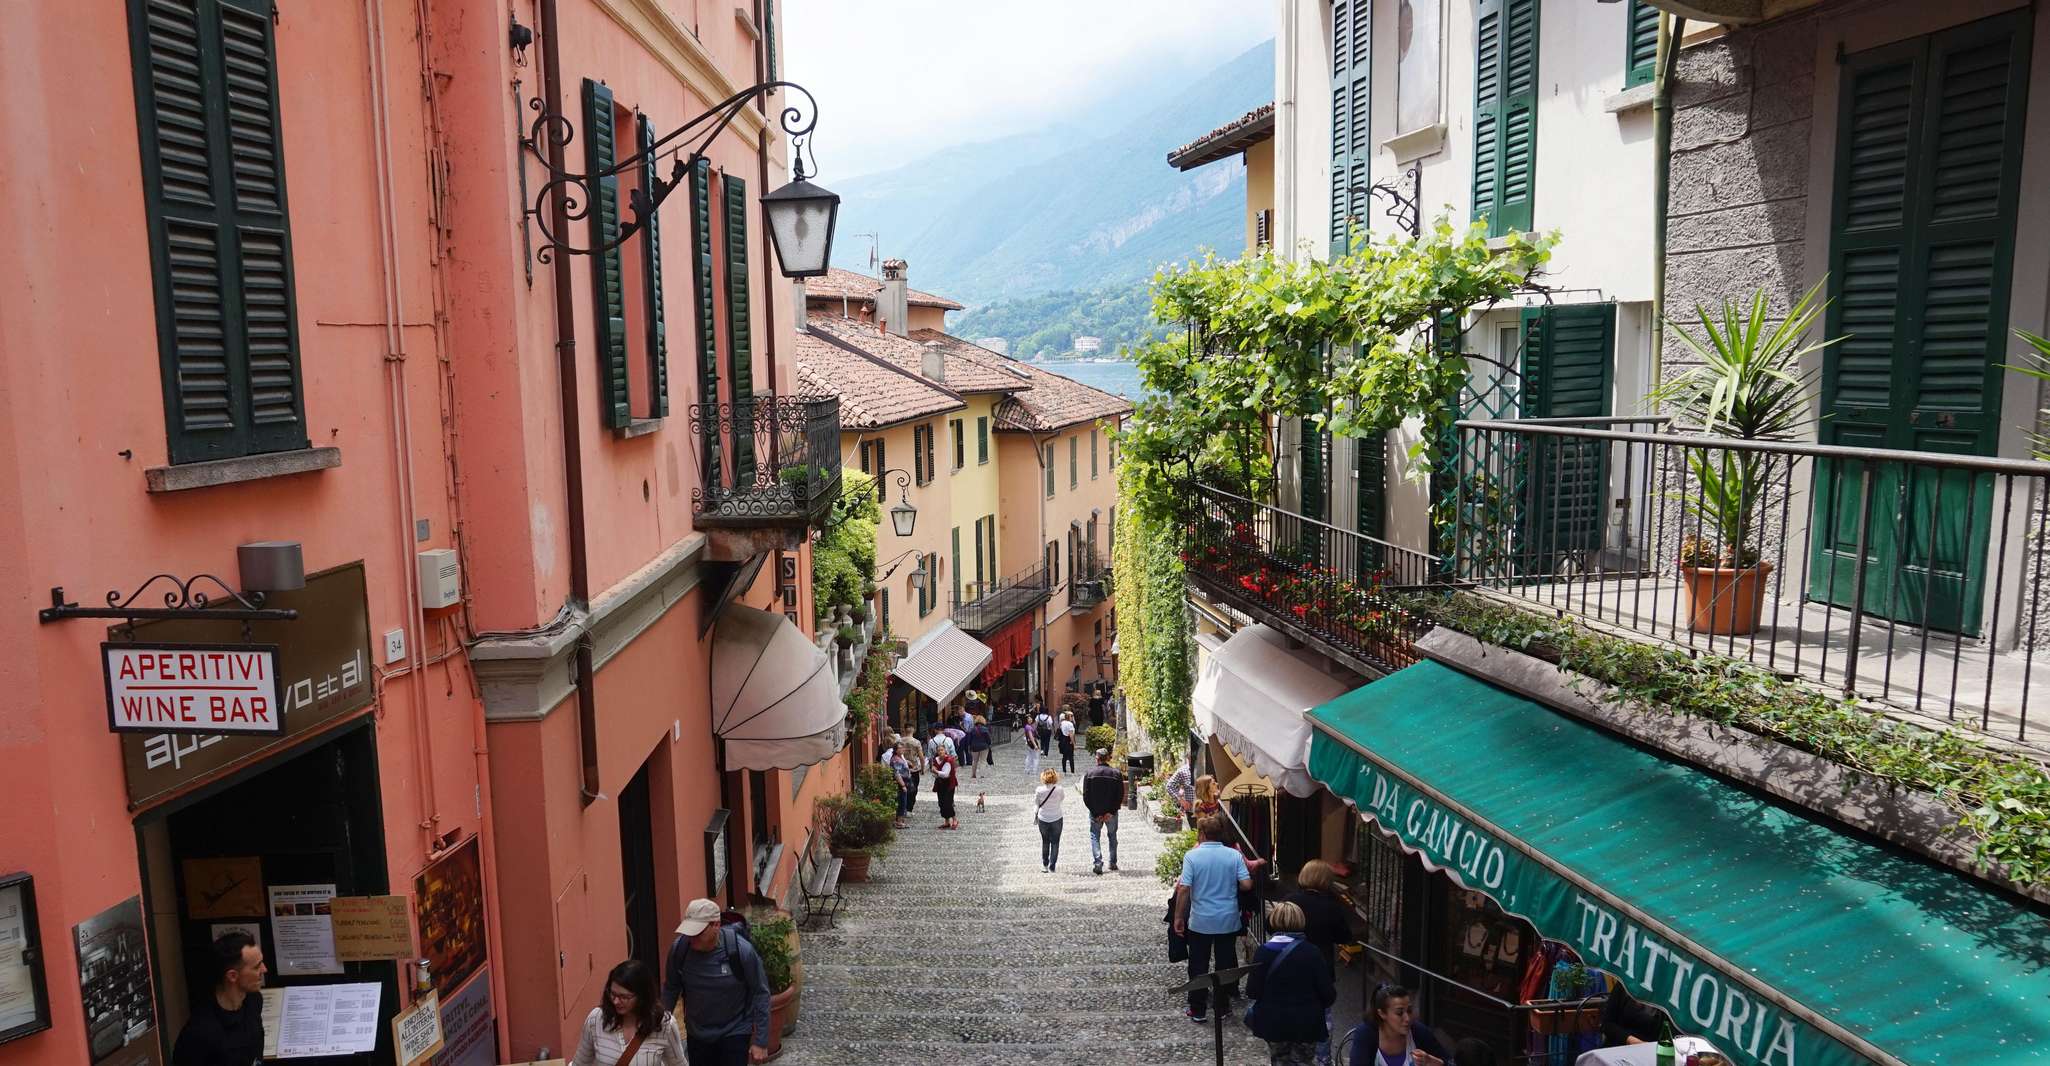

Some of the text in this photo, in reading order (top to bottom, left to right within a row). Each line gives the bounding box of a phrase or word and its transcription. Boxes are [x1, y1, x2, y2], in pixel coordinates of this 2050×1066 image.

[391, 640, 402, 653] 34
[119, 653, 264, 681] APERITIVI
[120, 696, 270, 723] WINE BAR
[1575, 893, 1797, 1066] TRATTORIA
[404, 1024, 435, 1052] WINE SHOP
